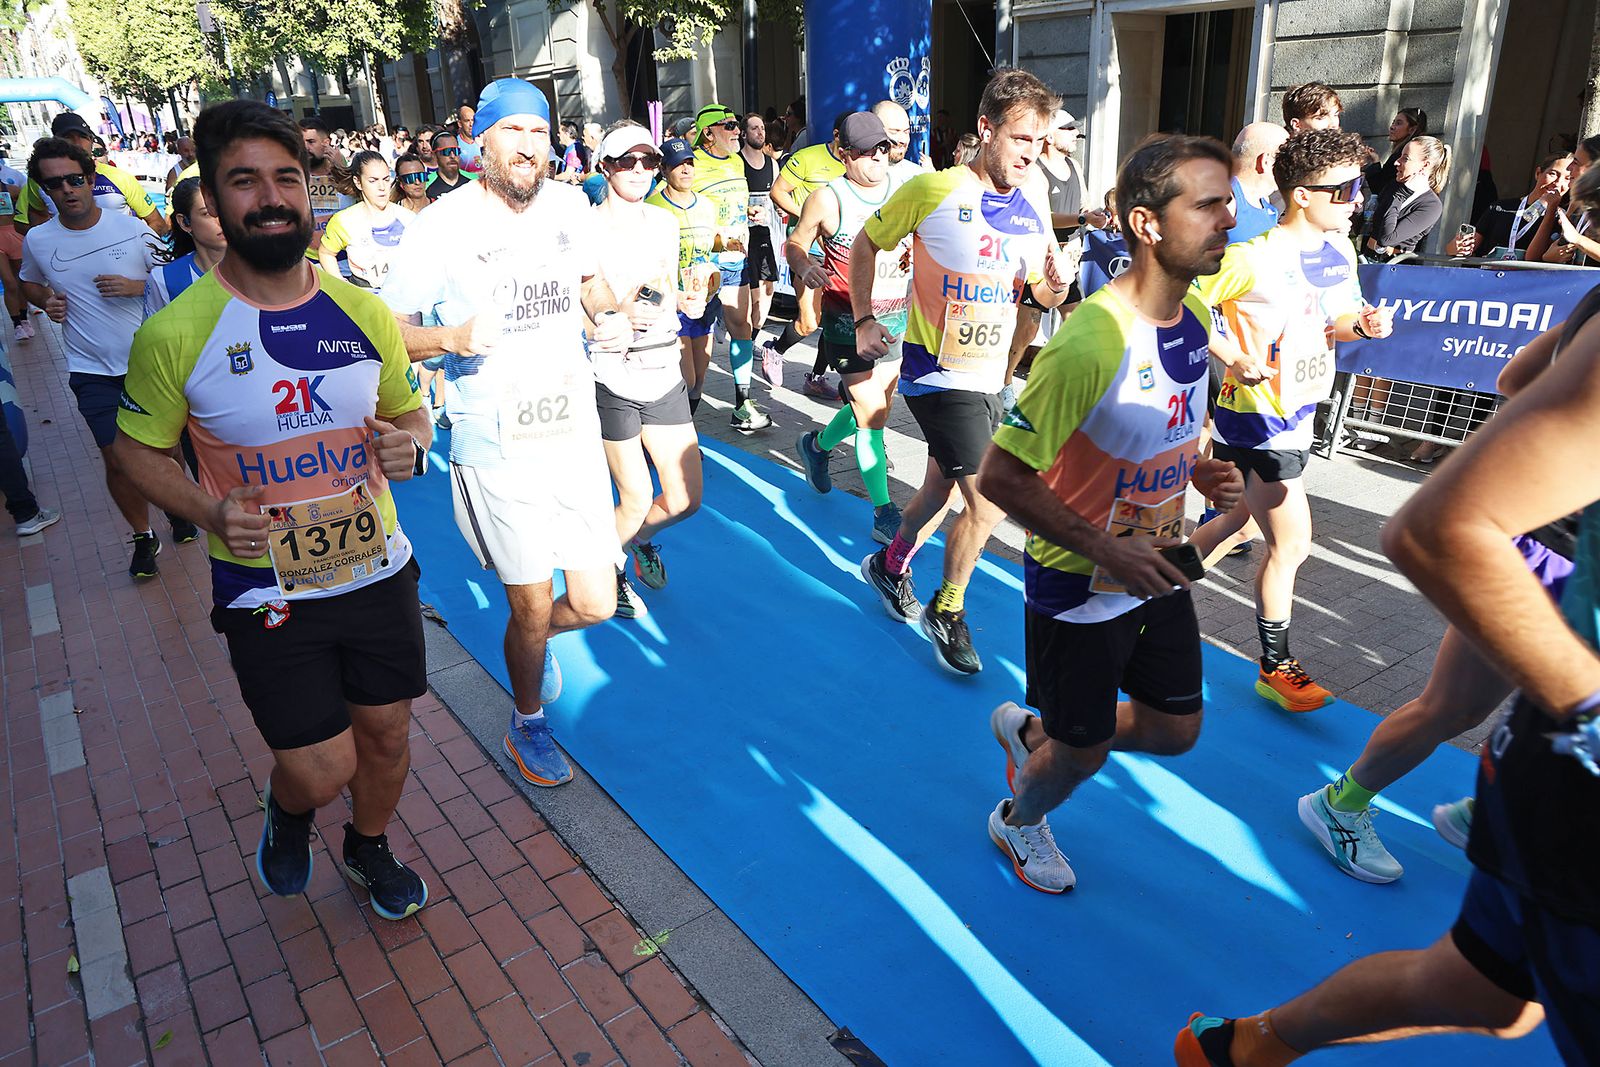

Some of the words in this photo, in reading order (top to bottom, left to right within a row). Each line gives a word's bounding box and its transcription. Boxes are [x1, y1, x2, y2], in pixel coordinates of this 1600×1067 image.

[979, 234, 1010, 262] 21K
[516, 296, 571, 321] DESTINO
[1377, 298, 1554, 332] HYUNDAI
[317, 339, 366, 354] AVATEL
[958, 322, 1002, 346] 965
[1295, 354, 1327, 383] 865
[271, 374, 333, 415] 21K
[1221, 382, 1238, 401] 21K
[276, 411, 334, 432] HUELVA
[517, 394, 569, 426] 862
[1167, 386, 1196, 430] 21K
[236, 441, 368, 486] Huelva
[331, 471, 371, 488] original
[322, 509, 344, 518] HUELVA
[280, 511, 376, 561] 1379
[279, 562, 333, 578] GONZALEZ
[334, 544, 383, 568] CORRALES
